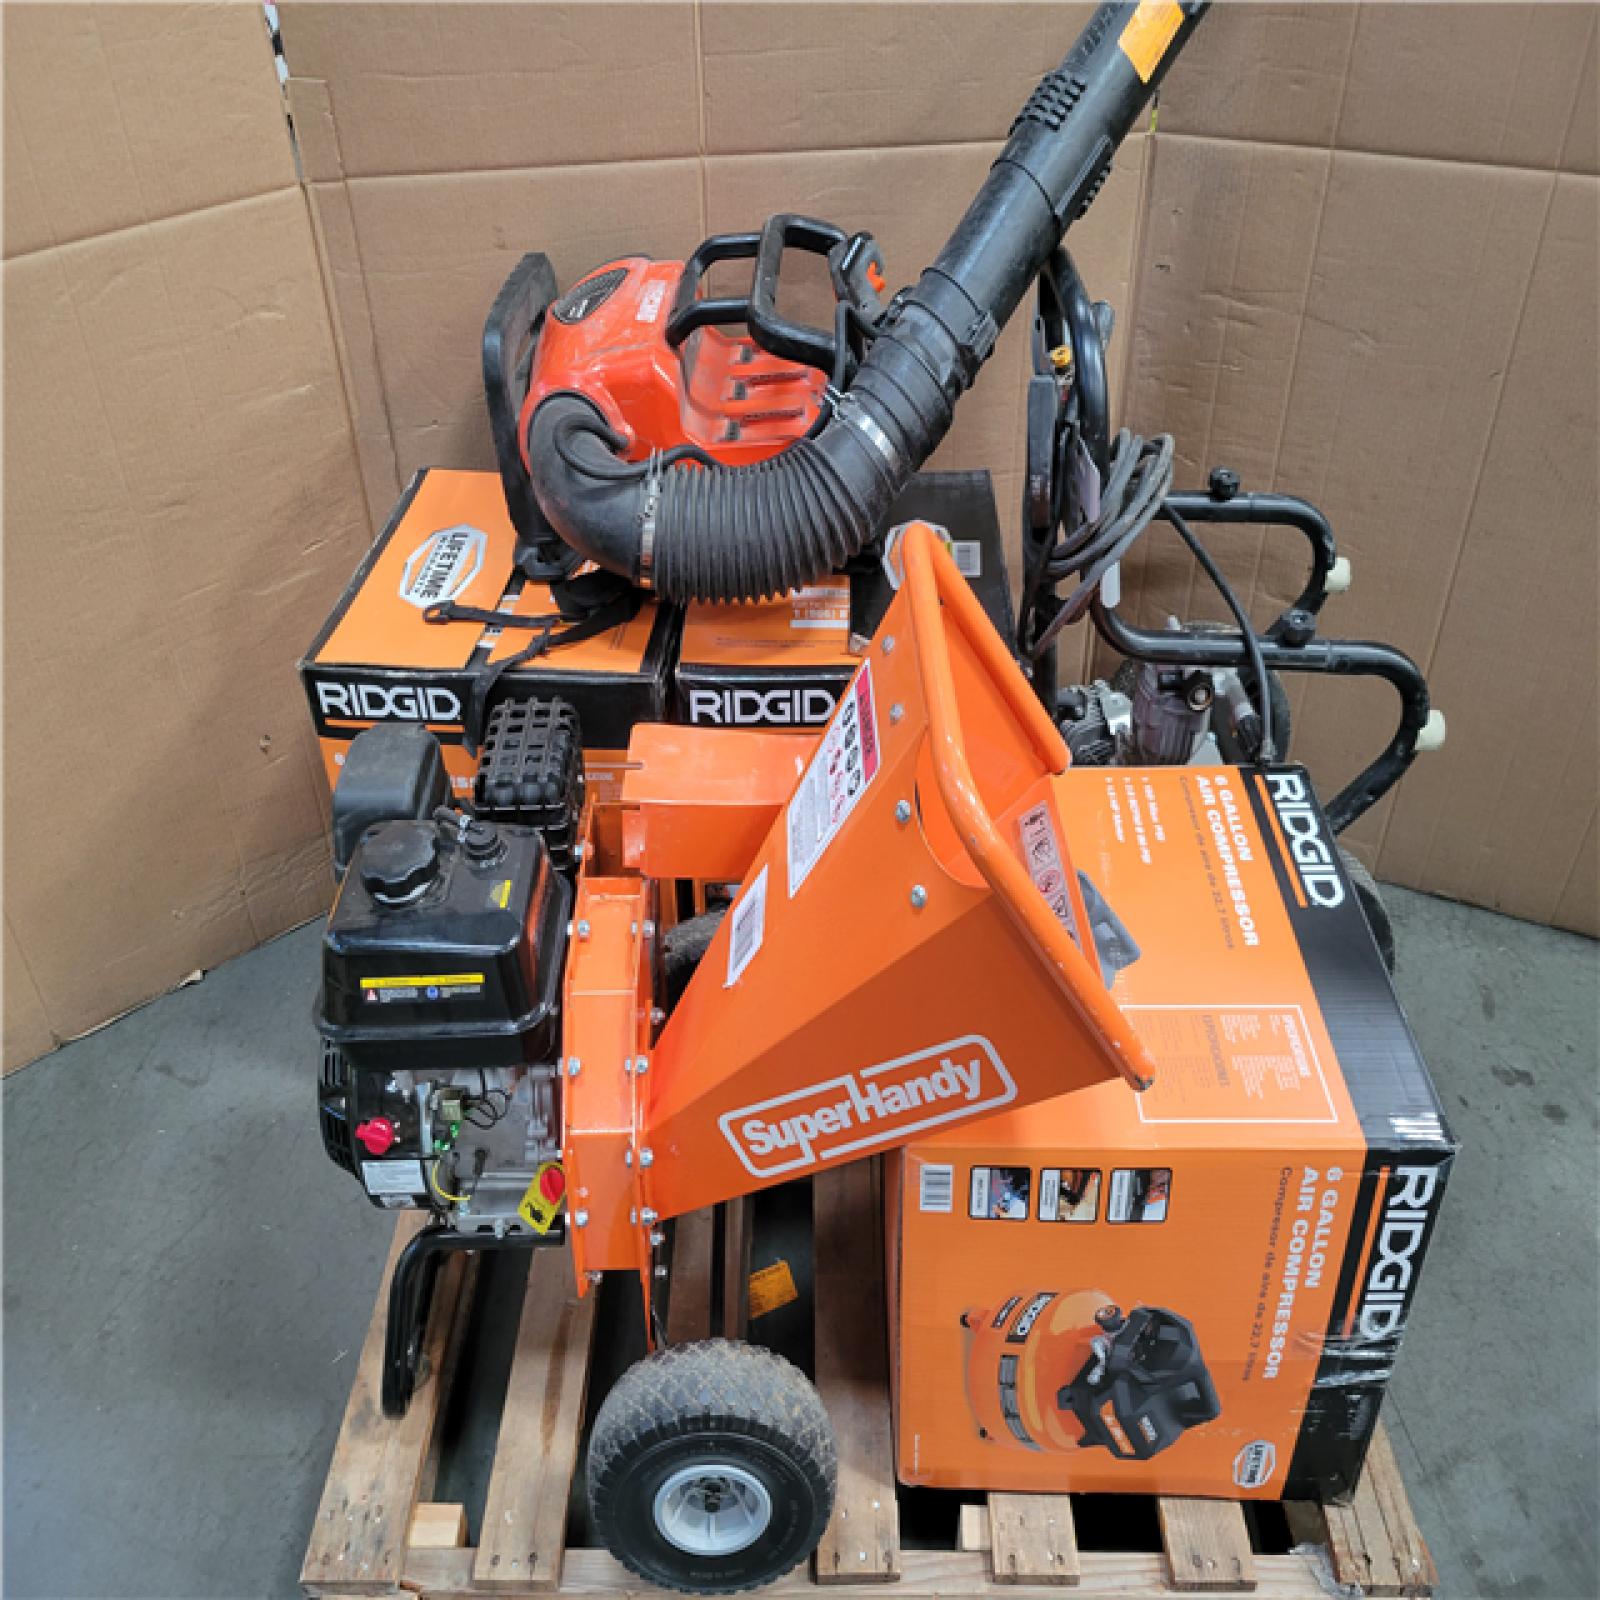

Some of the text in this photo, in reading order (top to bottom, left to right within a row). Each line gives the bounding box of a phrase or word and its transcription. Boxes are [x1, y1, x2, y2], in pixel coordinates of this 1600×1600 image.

[315, 680, 461, 721] RIDGID
[689, 689, 836, 724] RIDGID
[1195, 775, 1260, 946] AIR COMPRESSOR
[1214, 775, 1254, 861] 6 GALLON
[1265, 774, 1346, 908] RIDGID
[742, 1058, 981, 1161] SuperHandy
[1262, 1166, 1320, 1379] AIR COMPRESSOR
[1304, 1166, 1344, 1288] 6 GALLON
[1359, 1166, 1440, 1340] RIDGID
